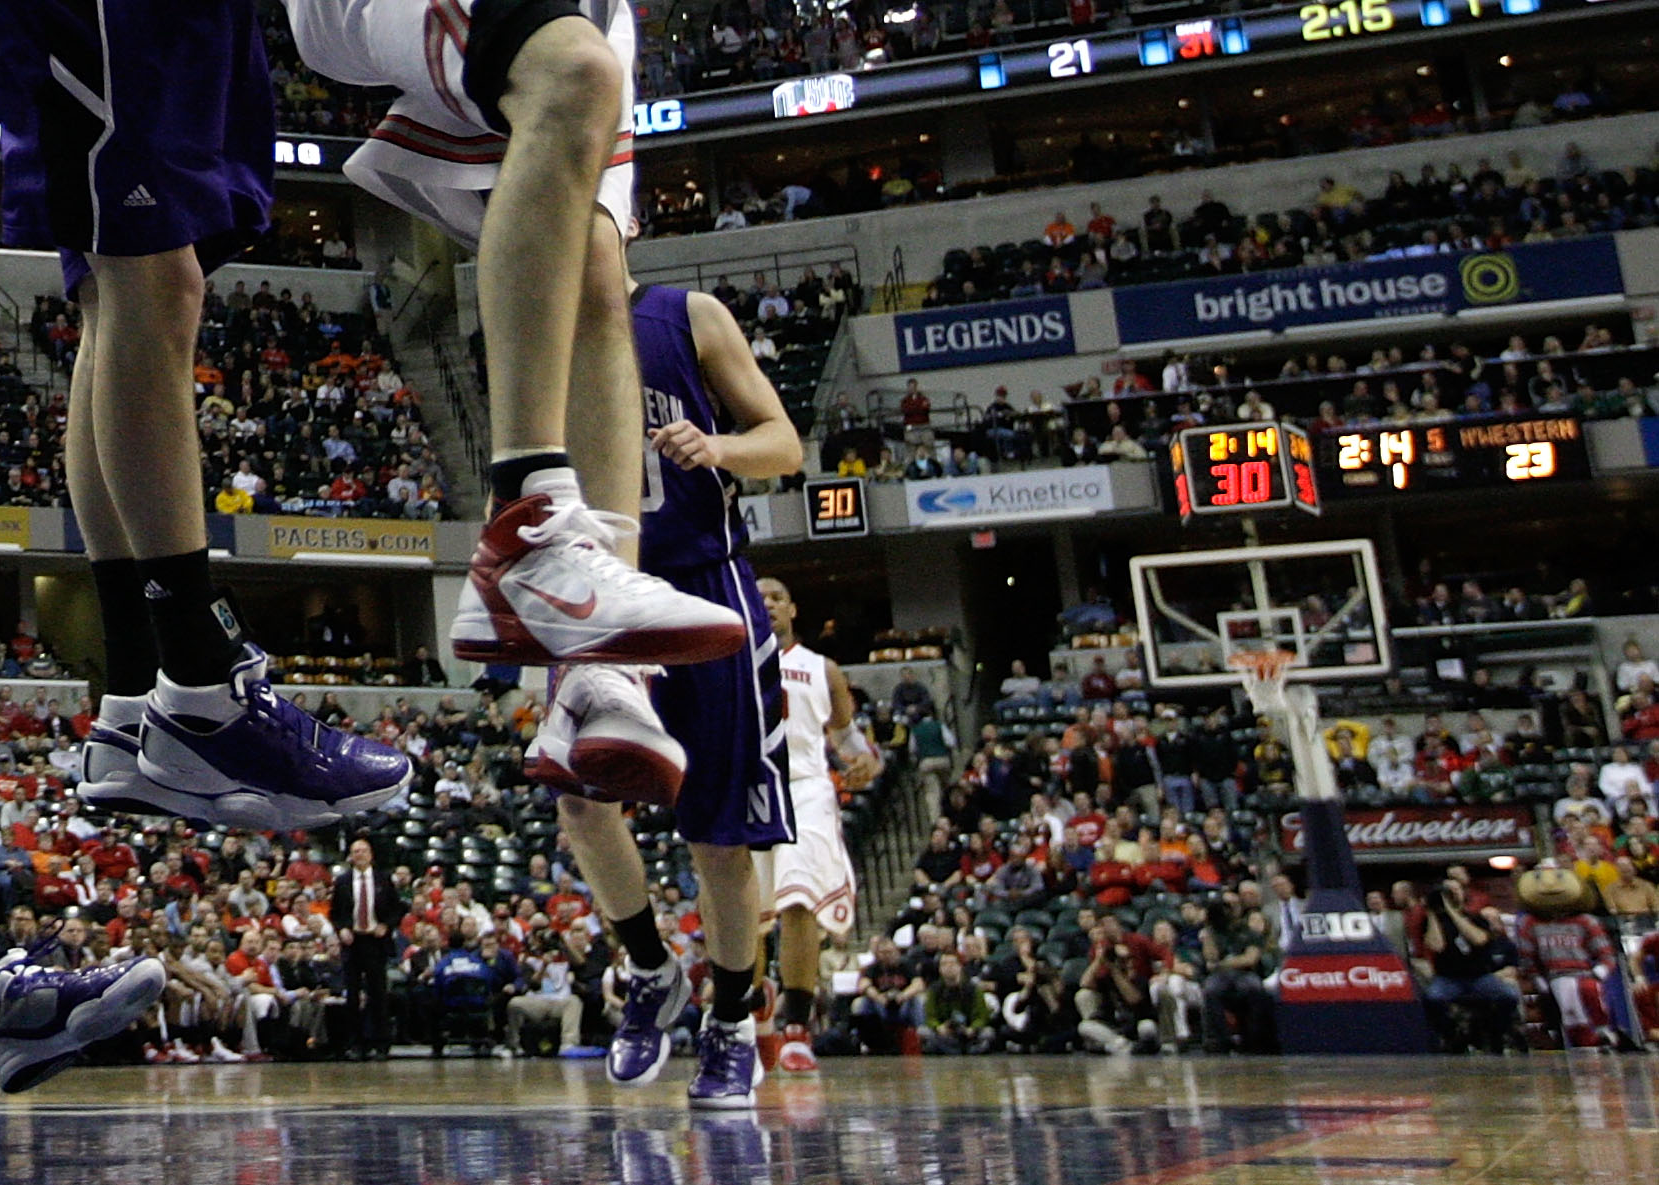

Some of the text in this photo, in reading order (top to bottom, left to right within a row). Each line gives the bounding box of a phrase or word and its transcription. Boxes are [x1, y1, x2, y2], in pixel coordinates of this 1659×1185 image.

[1048, 39, 1094, 78] 21
[1194, 272, 1447, 323] bright house
[904, 311, 1066, 357] LEGENDS
[1209, 427, 1278, 461] 2:14
[1339, 429, 1415, 470] 2:14
[1506, 442, 1558, 480] 23
[991, 479, 1101, 507] Kinetico
[1210, 461, 1270, 505] 30
[818, 488, 854, 520] 30
[1280, 966, 1408, 991] Great Clips
